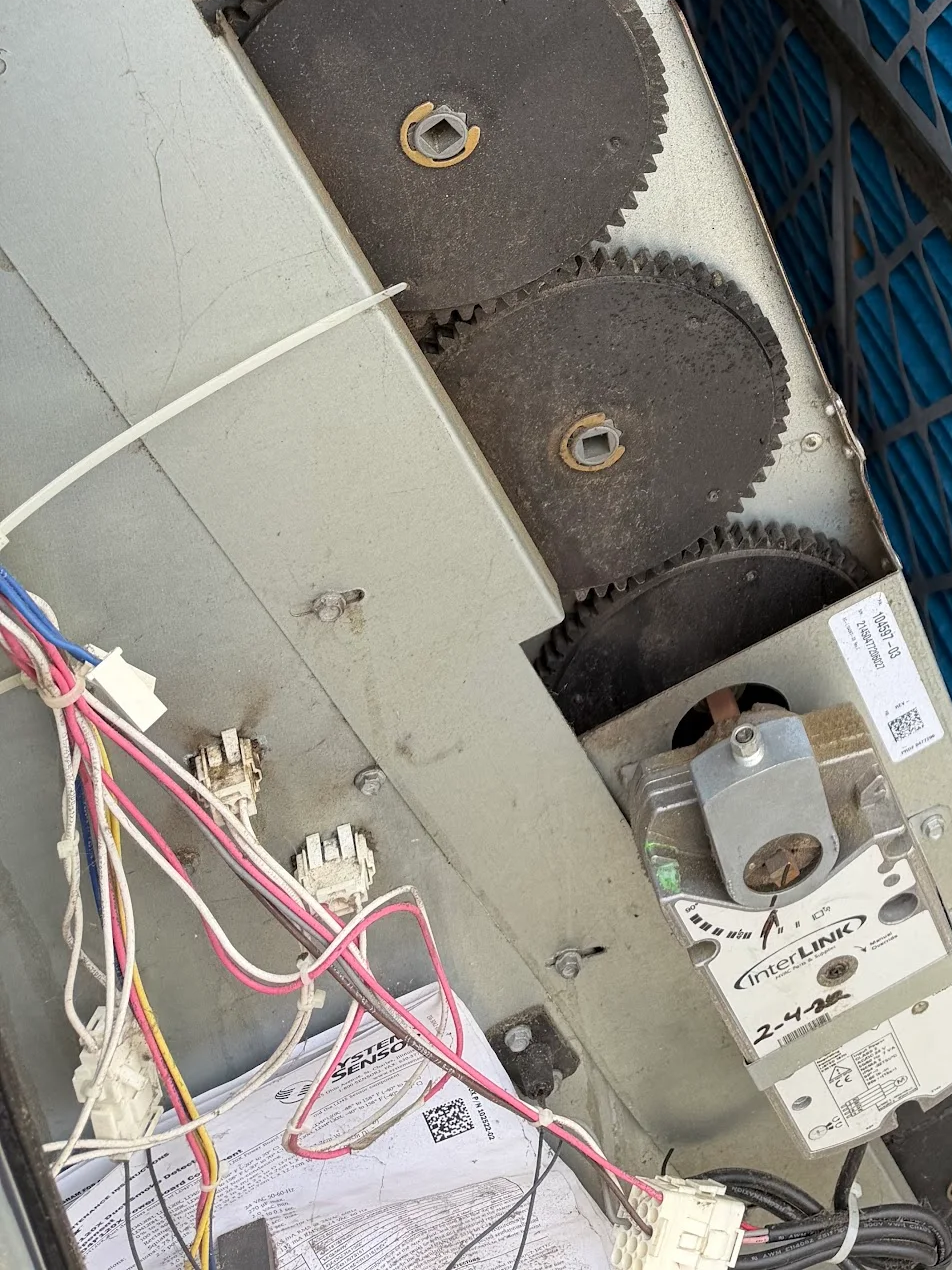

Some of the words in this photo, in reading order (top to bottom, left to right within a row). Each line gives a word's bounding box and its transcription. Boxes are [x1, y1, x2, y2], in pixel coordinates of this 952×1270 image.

[745, 918, 856, 985] InterLINK
[868, 930, 893, 946] Manual
[870, 932, 898, 950] Override
[329, 1038, 408, 1083] SENSO
